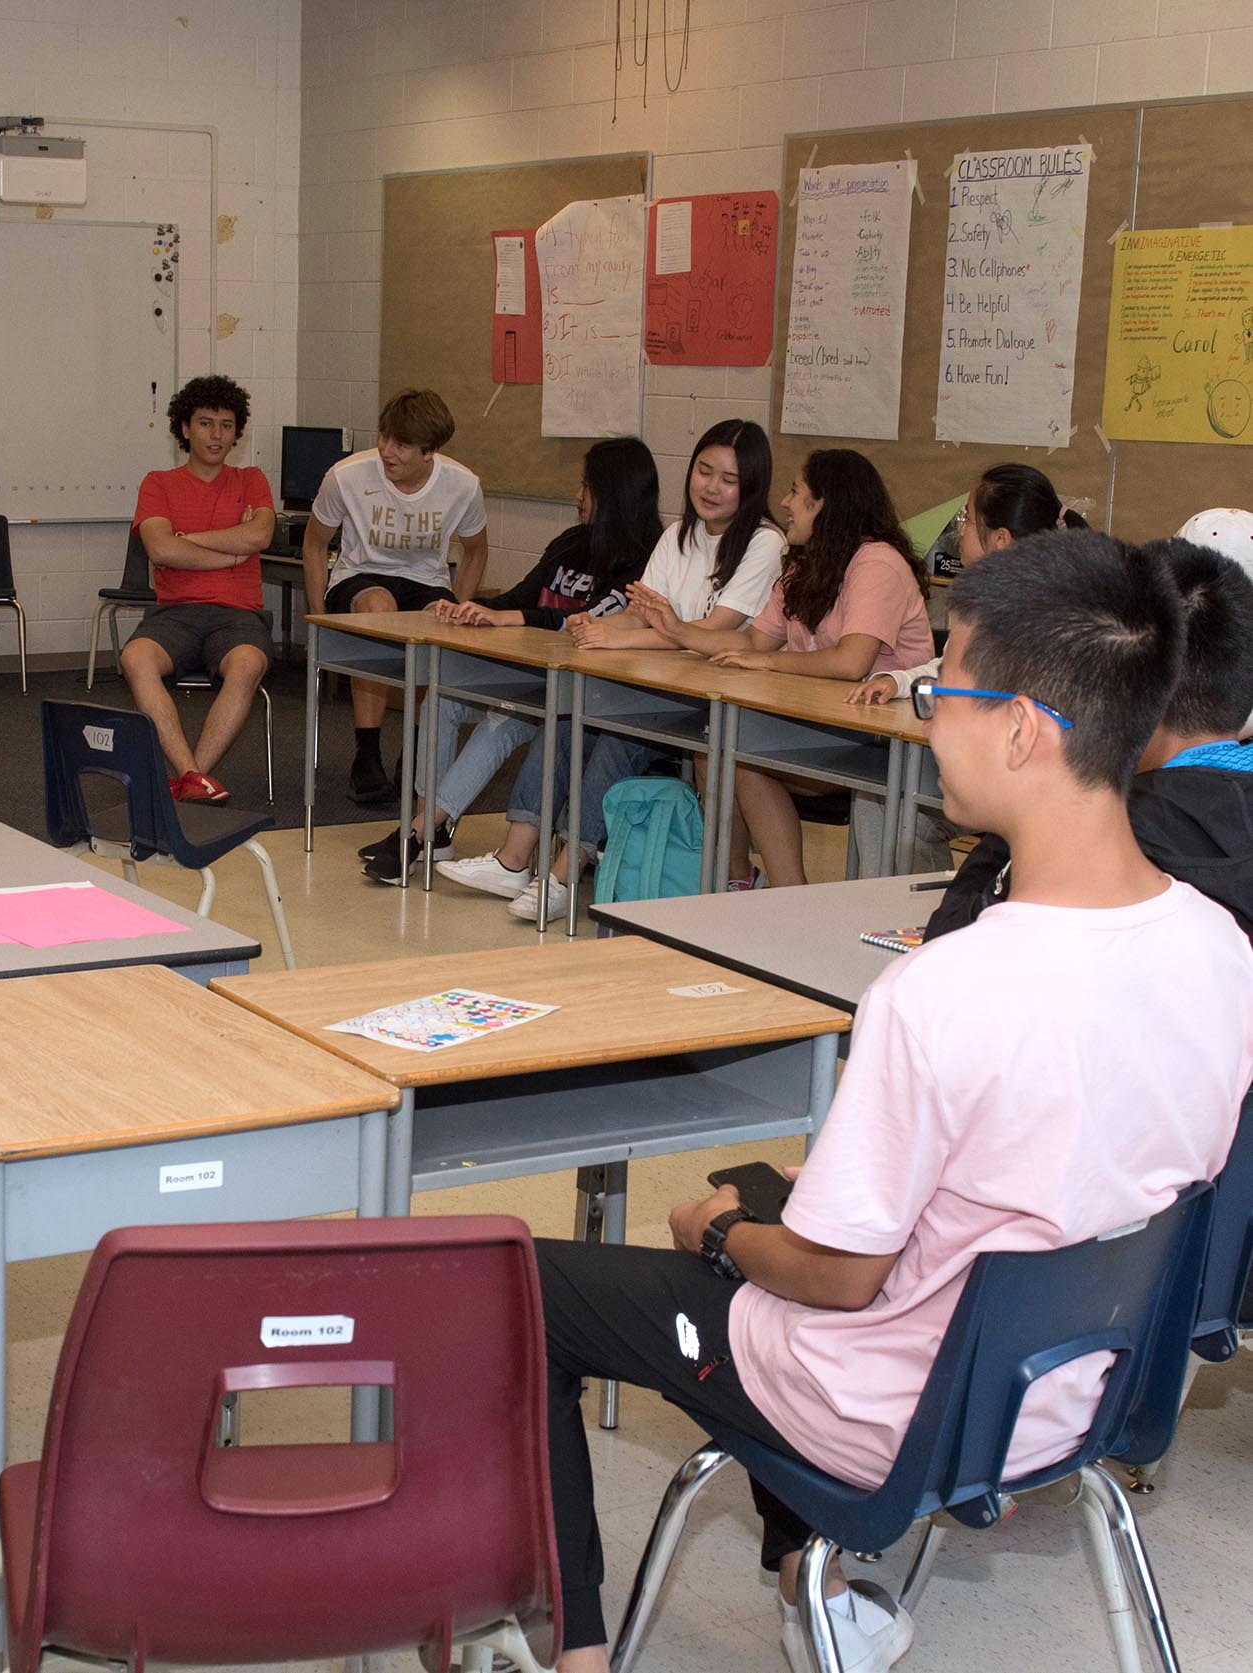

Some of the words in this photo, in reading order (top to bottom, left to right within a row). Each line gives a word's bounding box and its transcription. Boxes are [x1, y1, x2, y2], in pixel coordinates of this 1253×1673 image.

[958, 156, 1032, 180] CLASSROOM
[1040, 151, 1083, 175] RULES
[961, 186, 998, 214] Respect
[960, 222, 992, 250] Safety
[961, 258, 976, 278] No
[979, 258, 1026, 282] Cellphones
[959, 293, 972, 314] Be
[977, 294, 1010, 320] Helpful
[959, 328, 993, 348] Promote
[1172, 328, 1217, 354] Carol
[957, 364, 981, 385] Have
[986, 364, 1009, 386] Fun!
[371, 505, 396, 528] WE
[403, 511, 443, 532] THE
[368, 529, 443, 550] NORTH
[940, 560, 951, 571] 25
[91, 731, 111, 748] 102
[166, 1174, 194, 1184] Room
[198, 1170, 216, 1181] 102
[271, 1327, 312, 1338] Room
[317, 1325, 344, 1336] 102
